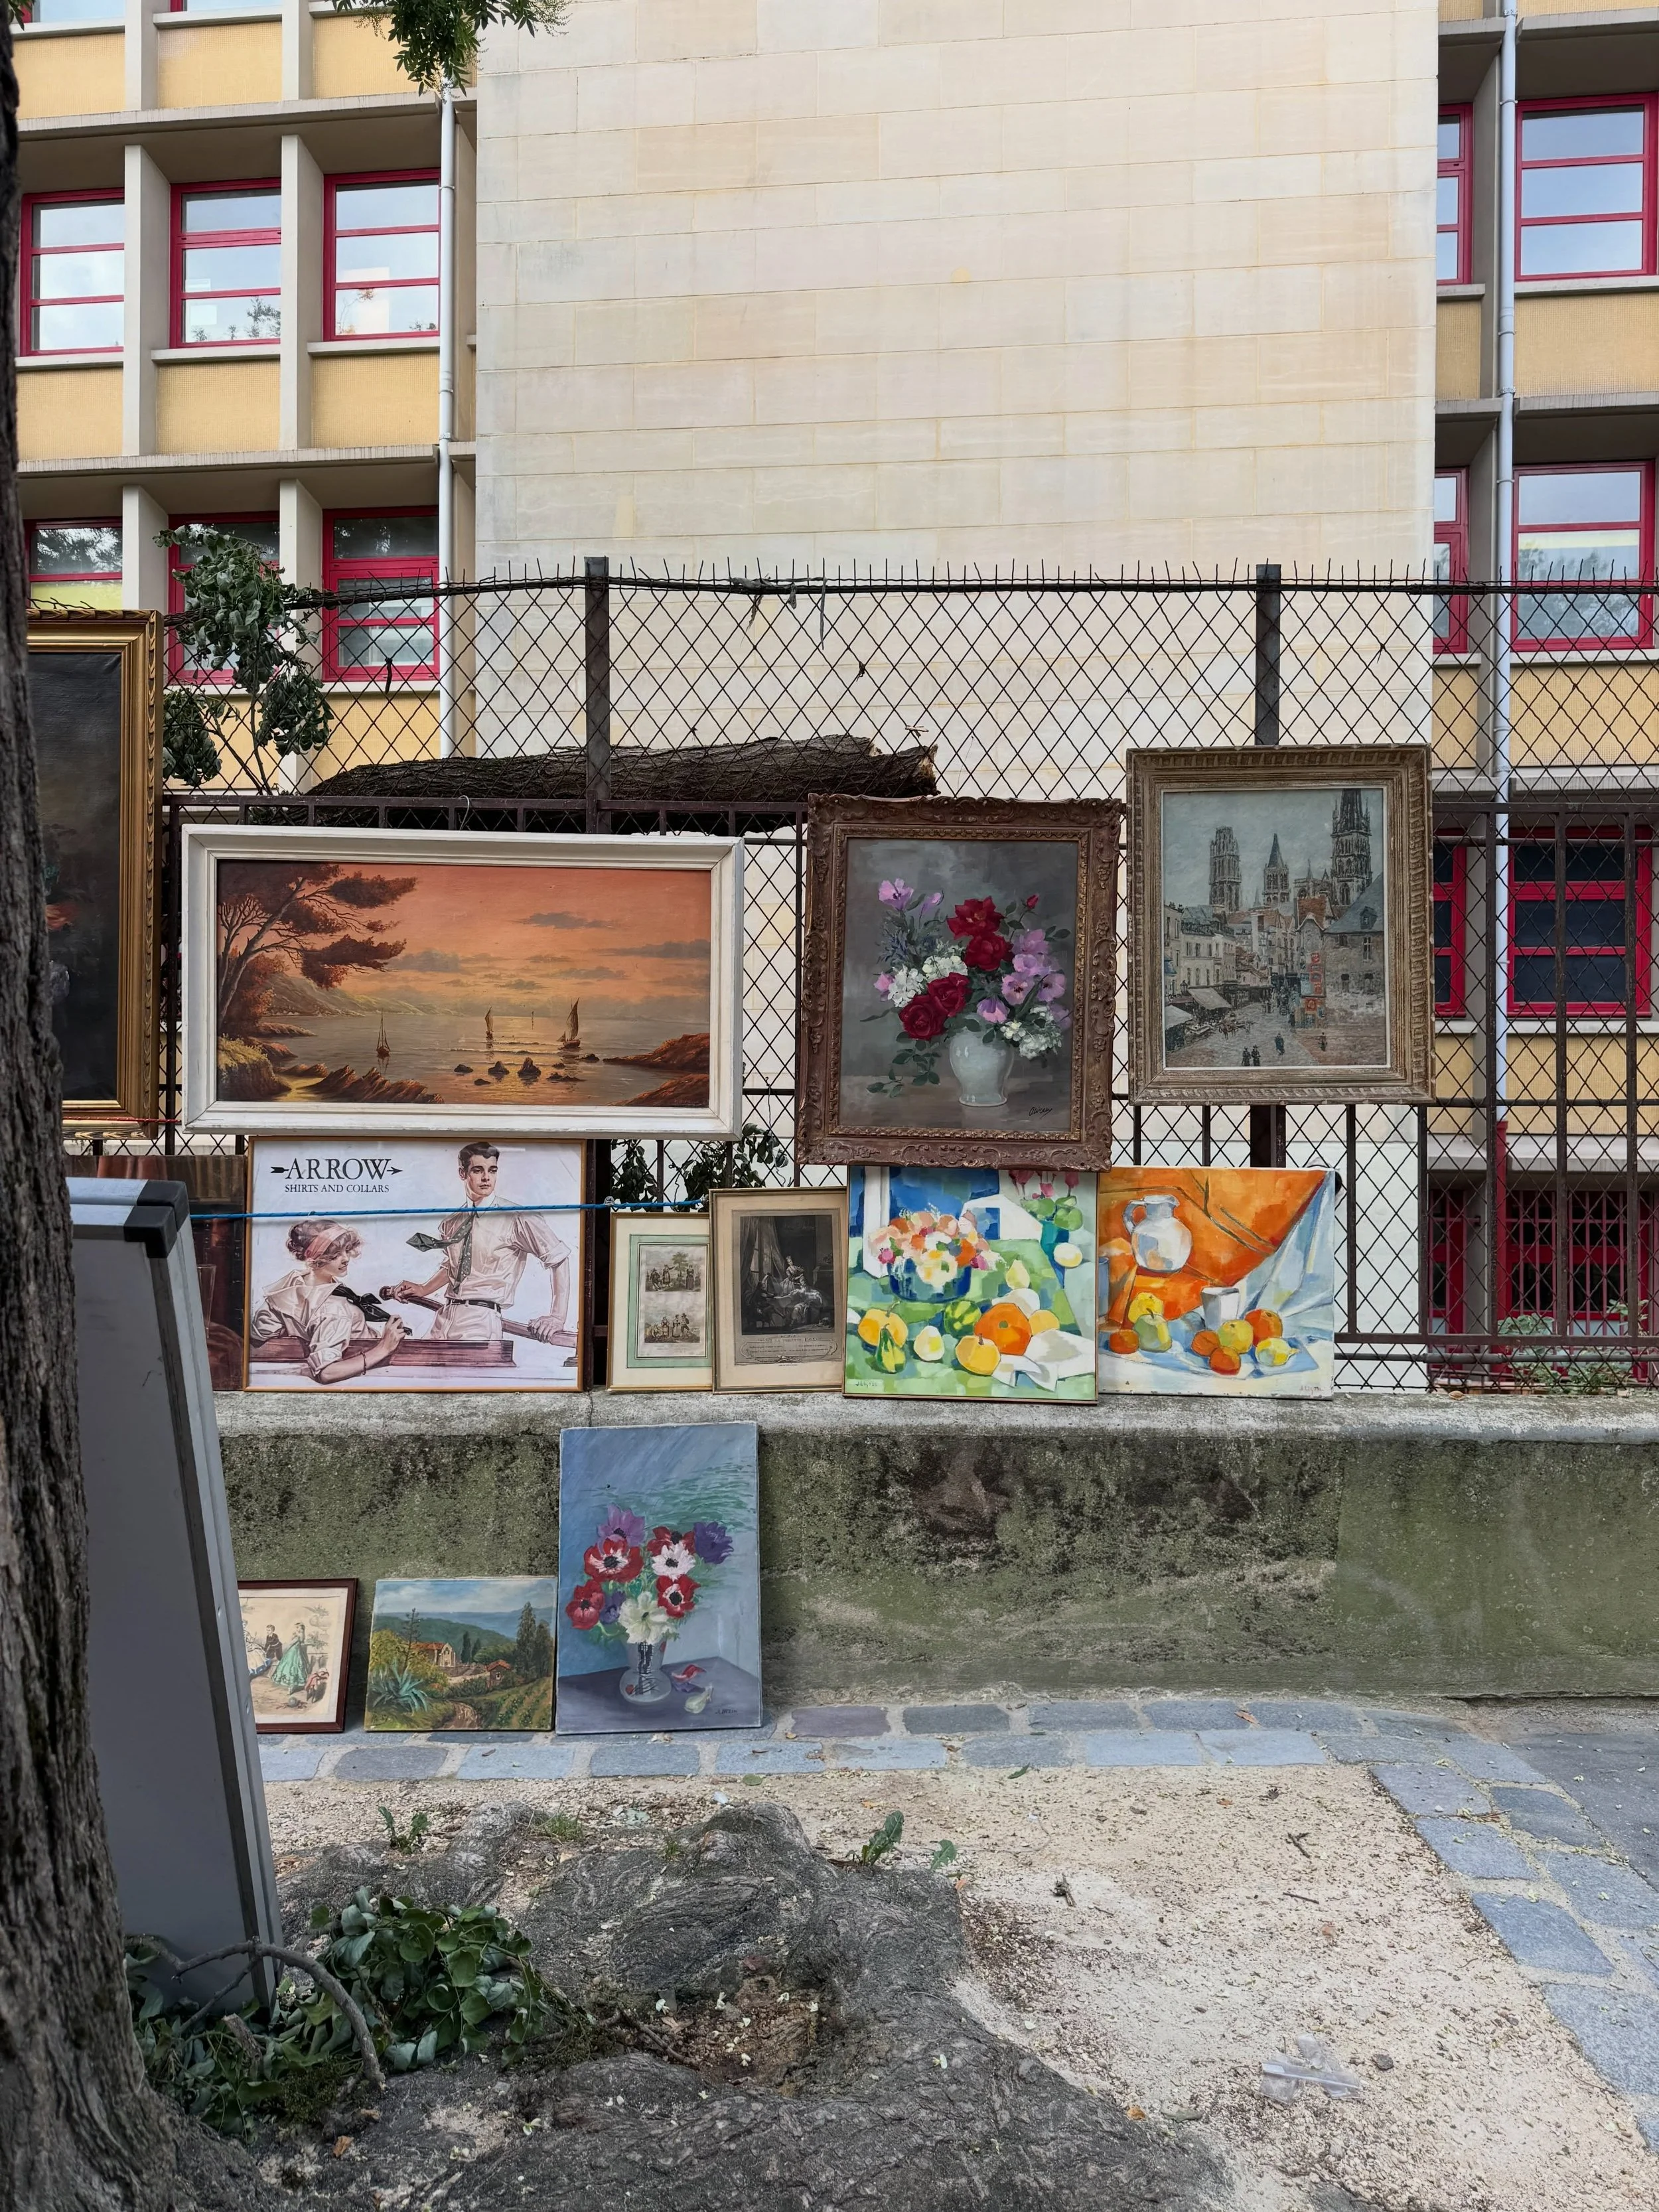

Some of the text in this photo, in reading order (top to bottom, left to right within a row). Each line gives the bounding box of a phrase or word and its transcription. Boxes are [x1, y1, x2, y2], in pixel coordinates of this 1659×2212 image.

[285, 1157, 392, 1180] ARROW
[285, 1184, 390, 1193] SHIRTS AND COLLARS
